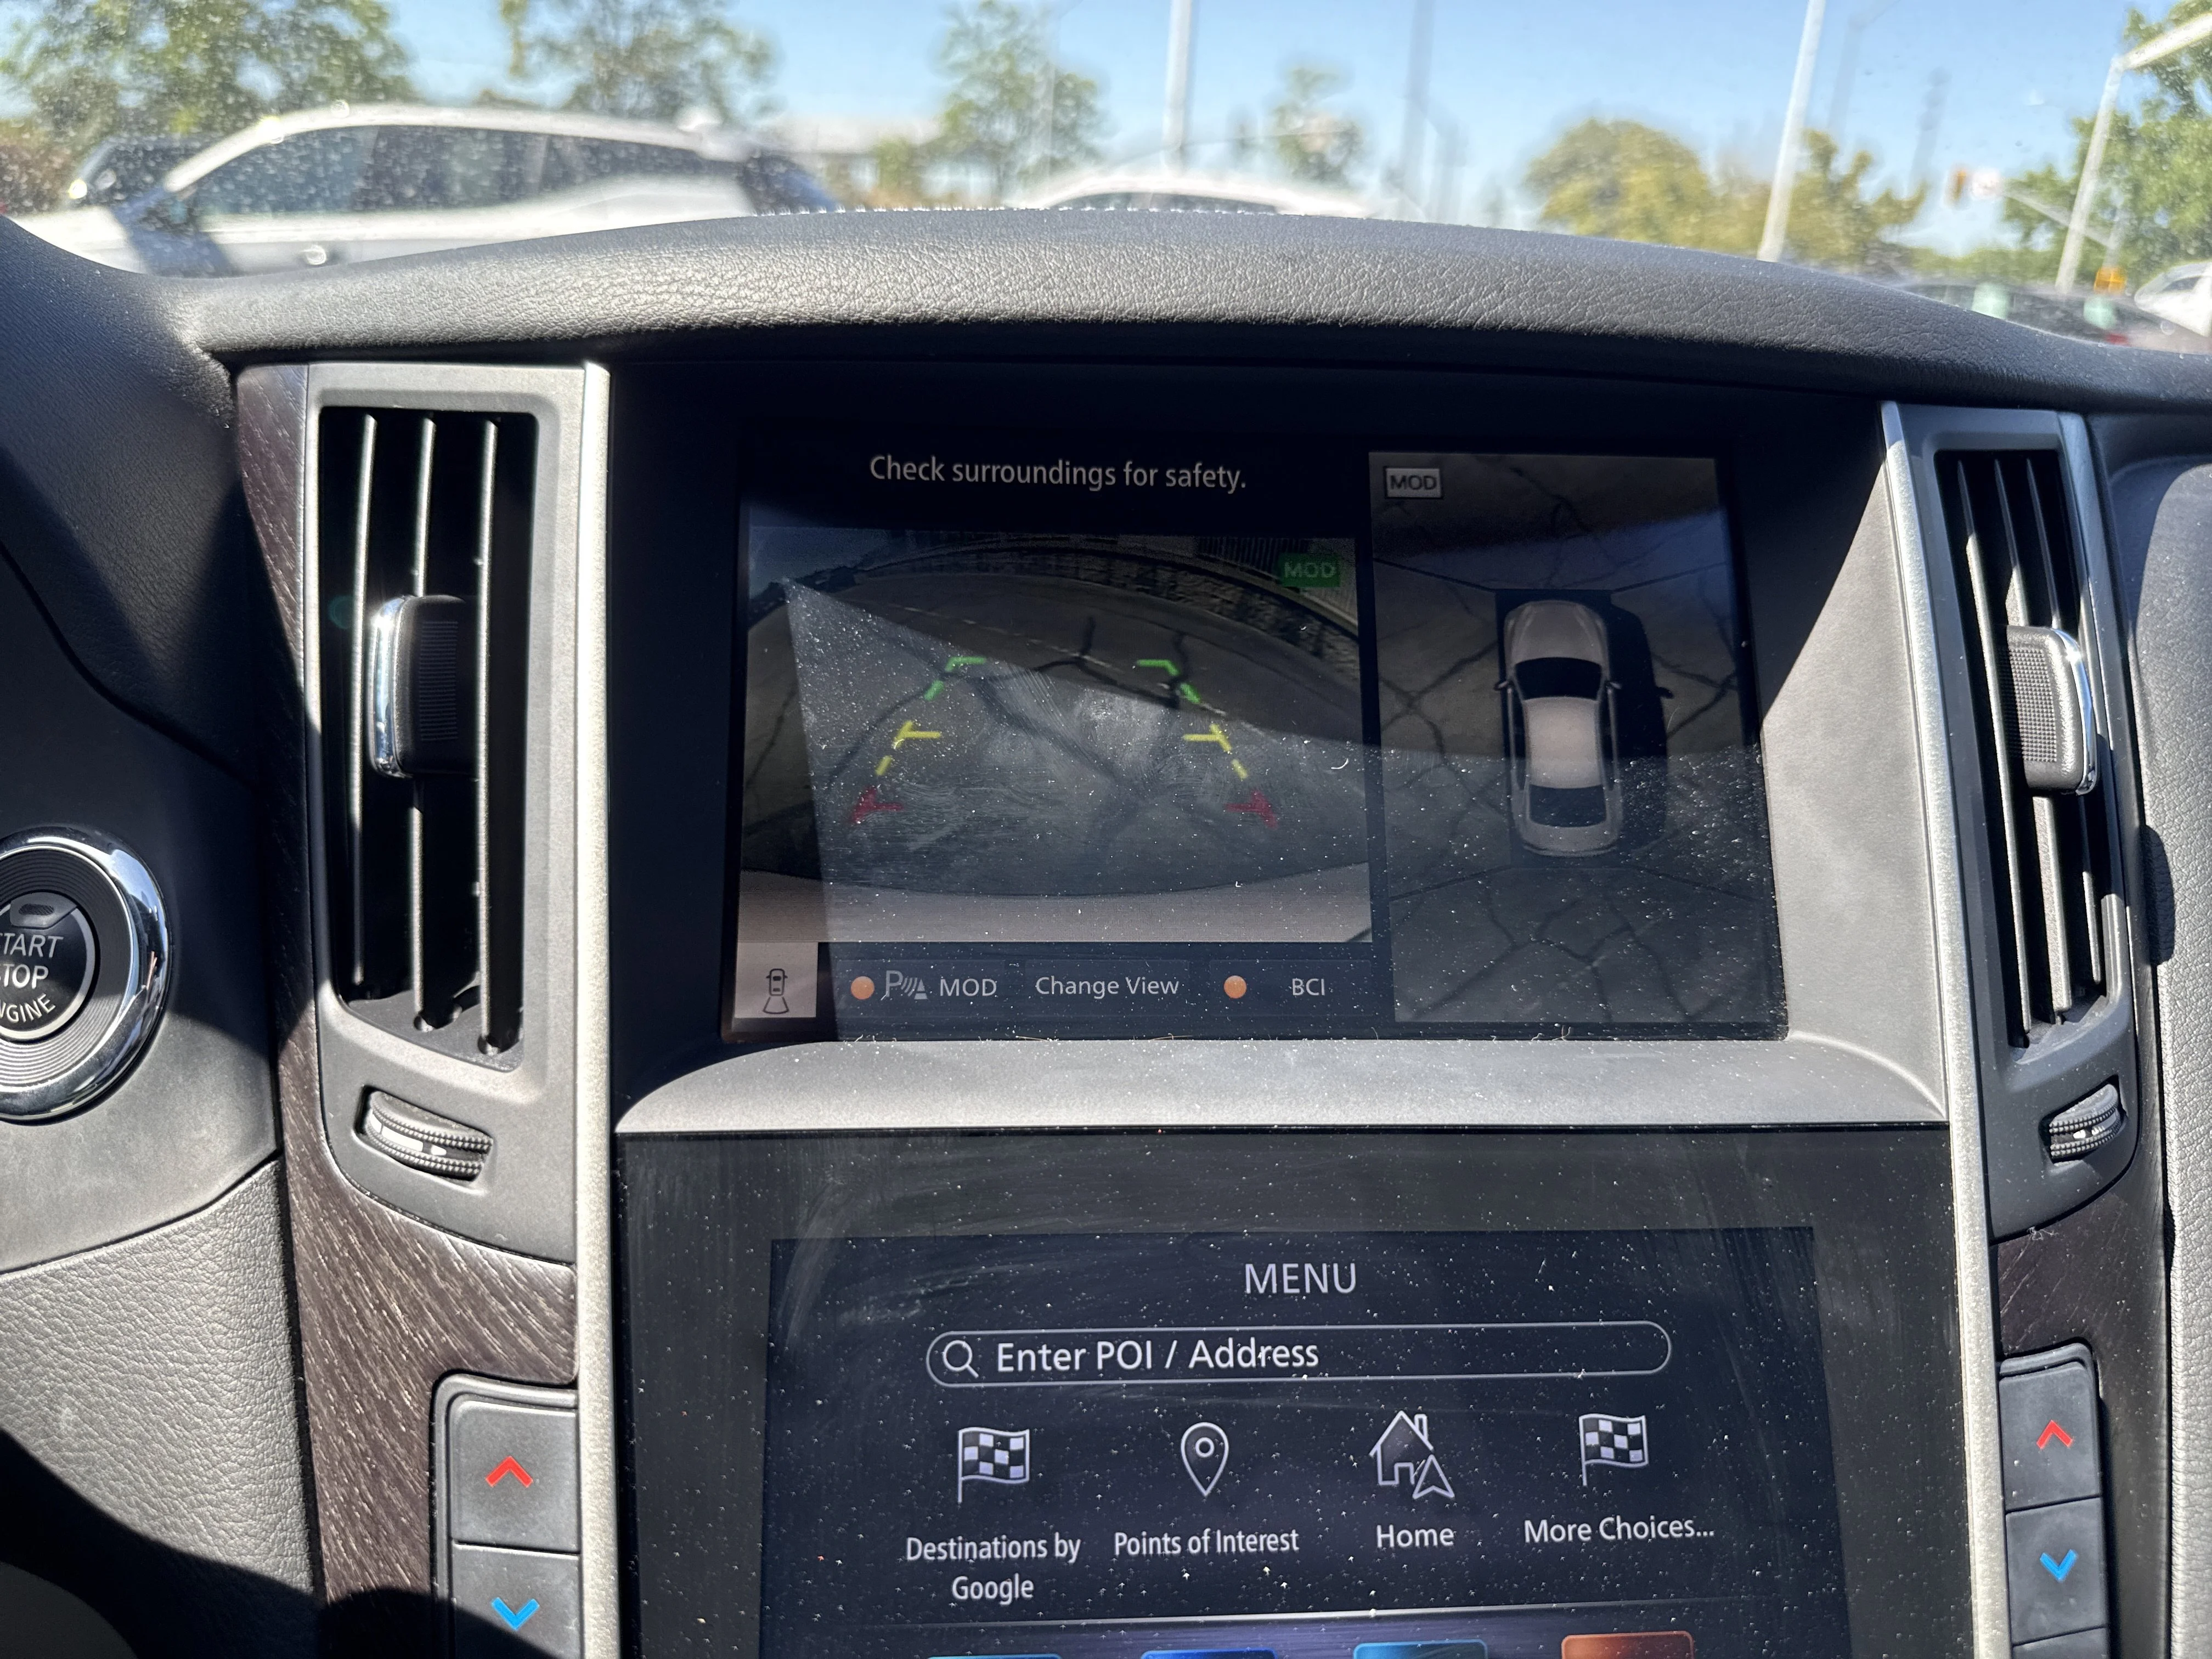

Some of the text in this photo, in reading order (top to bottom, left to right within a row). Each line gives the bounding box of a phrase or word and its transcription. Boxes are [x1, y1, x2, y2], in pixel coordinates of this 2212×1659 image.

[870, 455, 1246, 494] Check surroundings for safety.
[1390, 475, 1437, 490] MOD
[1284, 562, 1337, 578] MOD
[0, 933, 64, 958] TART
[0, 963, 49, 989] TOP
[940, 978, 997, 996] MOD
[1036, 975, 1180, 1000] Change View
[1292, 978, 1325, 996] BCI
[1245, 1263, 1357, 1294] MENU
[997, 1337, 1319, 1373] Enter POI / Address
[1376, 1524, 1455, 1548] Home
[1524, 1514, 1715, 1543] More Choices...
[906, 1532, 1081, 1564] Destinations by
[1114, 1528, 1300, 1556] Points of Interest
[951, 1573, 1035, 1606] Google
